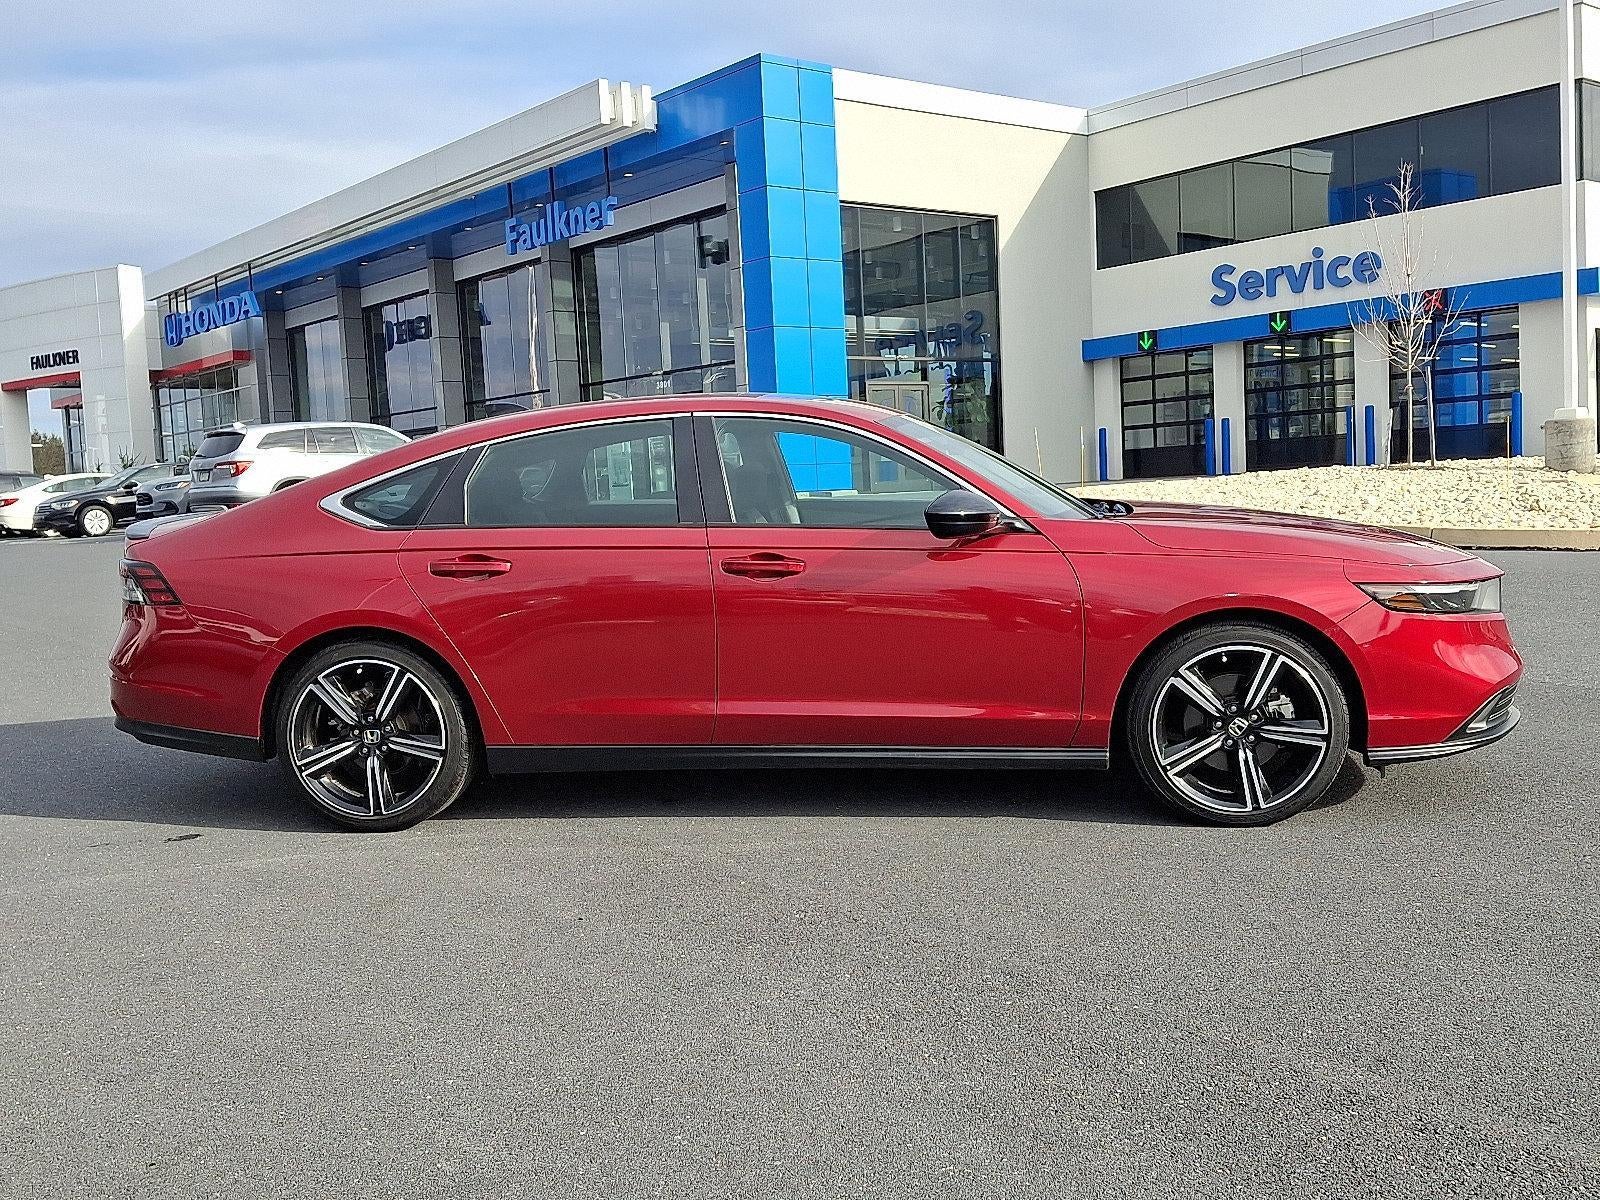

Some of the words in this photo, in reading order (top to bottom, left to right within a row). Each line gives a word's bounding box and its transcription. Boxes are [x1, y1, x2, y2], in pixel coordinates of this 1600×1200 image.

[504, 195, 618, 256] Faulkner
[1209, 246, 1383, 307] Service
[180, 290, 261, 337] HONDA
[30, 349, 80, 371] FAULKNER
